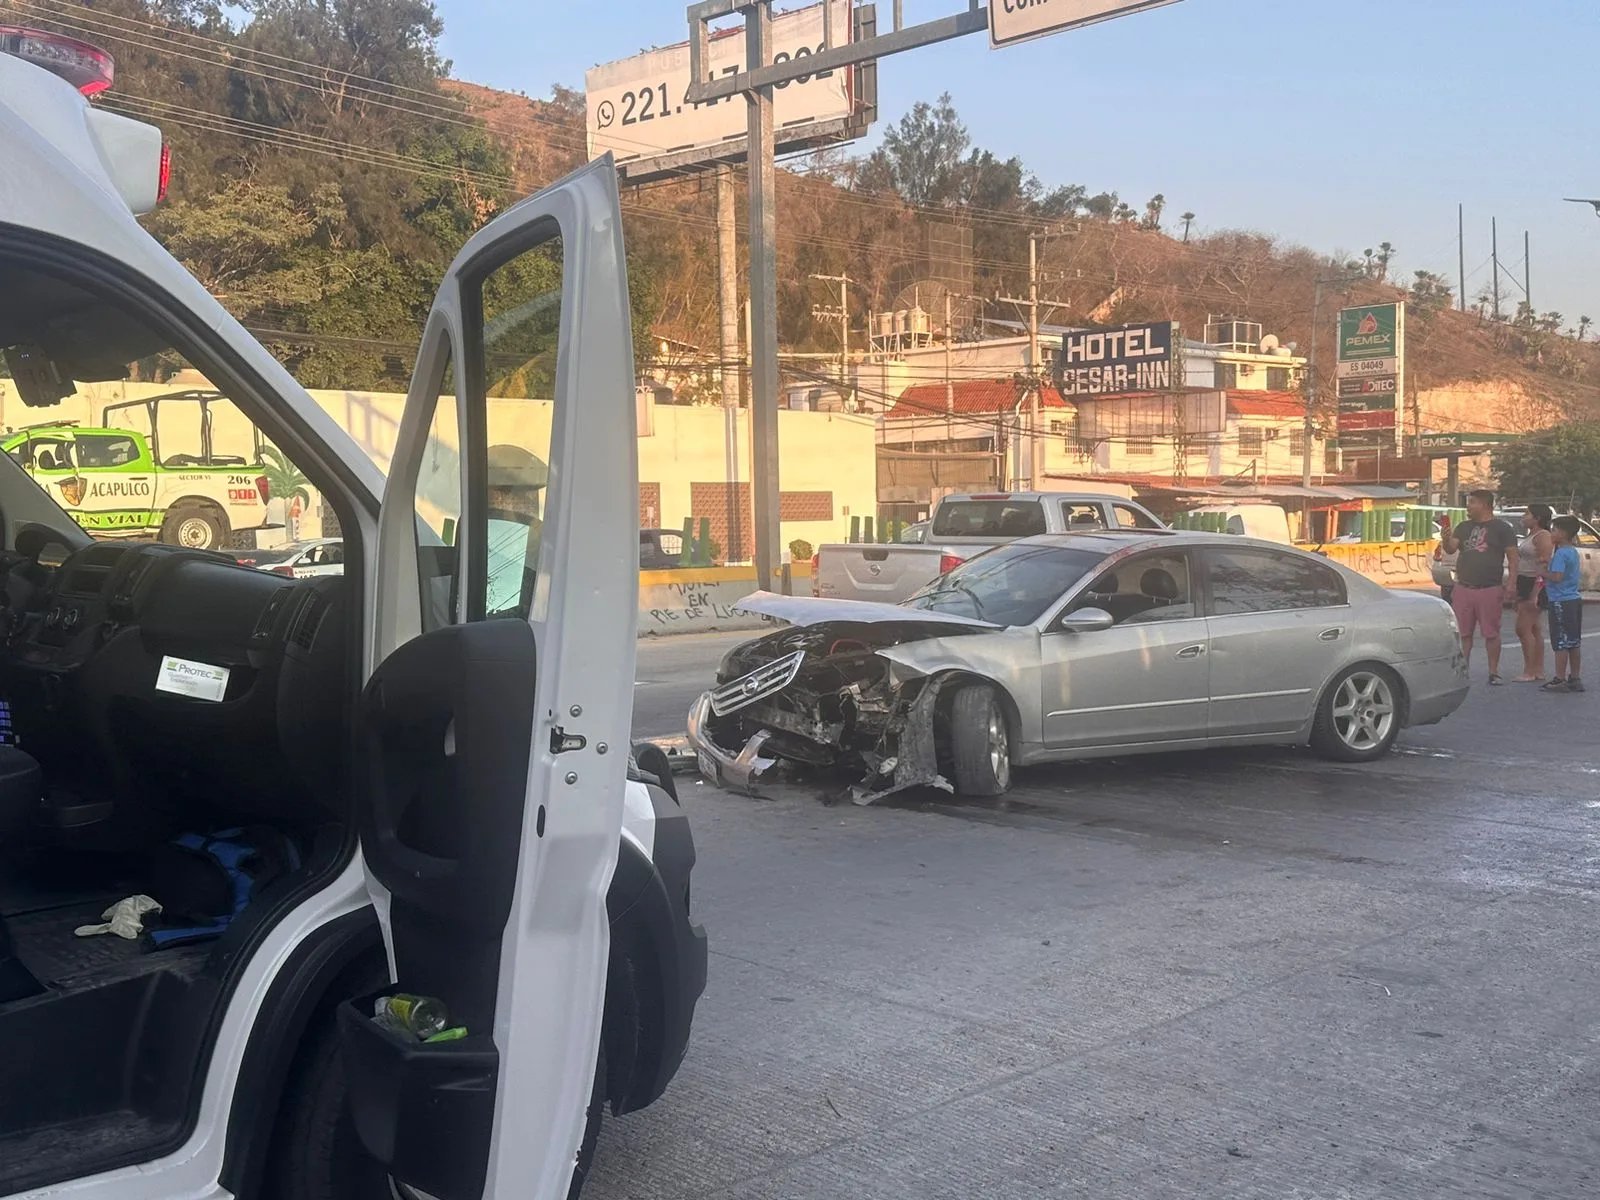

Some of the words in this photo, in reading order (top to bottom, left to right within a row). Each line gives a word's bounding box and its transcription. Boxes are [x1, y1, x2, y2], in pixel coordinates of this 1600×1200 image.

[1067, 328, 1165, 363] HOTEL
[1345, 333, 1391, 346] PEMEX
[1350, 362, 1359, 371] ES
[1360, 360, 1384, 370] 04049
[227, 475, 251, 485] 206
[89, 482, 150, 497] ACAPULCO
[688, 592, 709, 608] EN
[650, 608, 680, 624] PIE
[684, 607, 703, 620] DE
